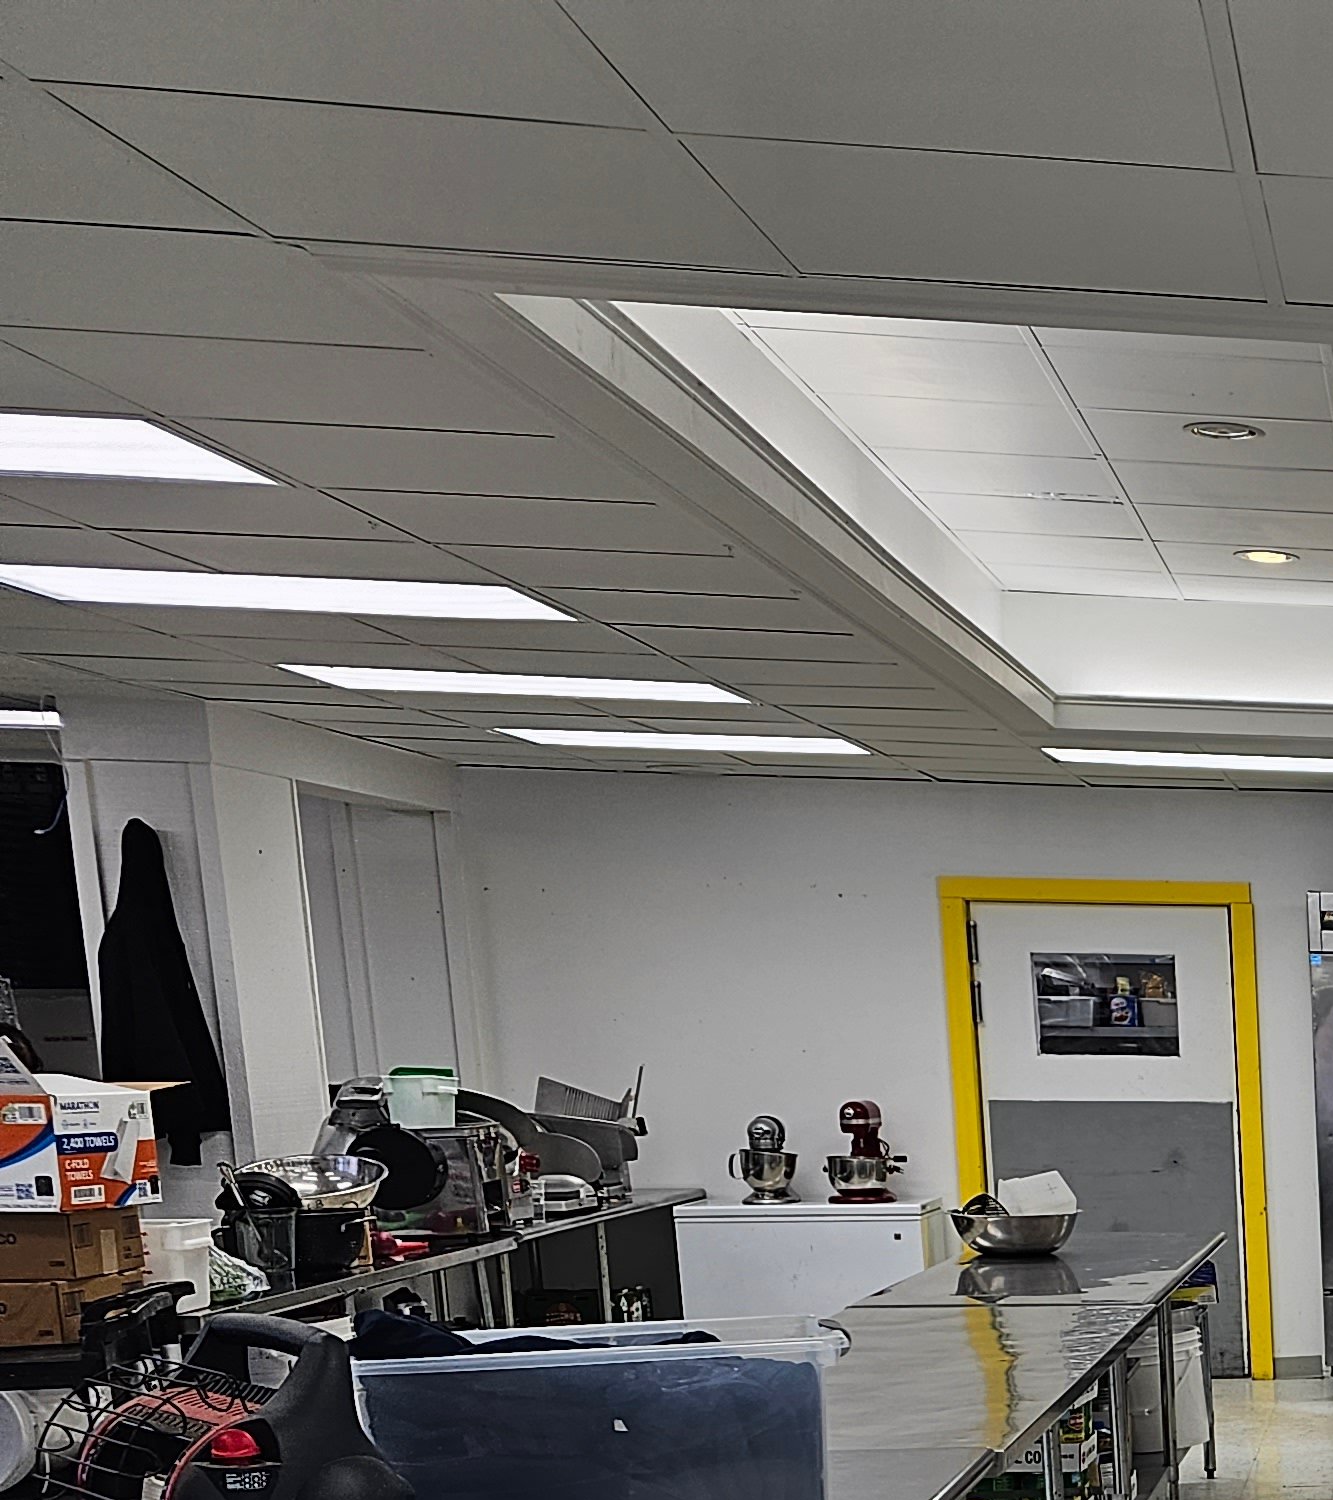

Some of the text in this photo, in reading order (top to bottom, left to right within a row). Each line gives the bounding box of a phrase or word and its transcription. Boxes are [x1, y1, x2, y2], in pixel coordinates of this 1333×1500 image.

[59, 1101, 99, 1112] MARATHON
[85, 1135, 116, 1148] TOWELS
[65, 1169, 94, 1181] TOWELS
